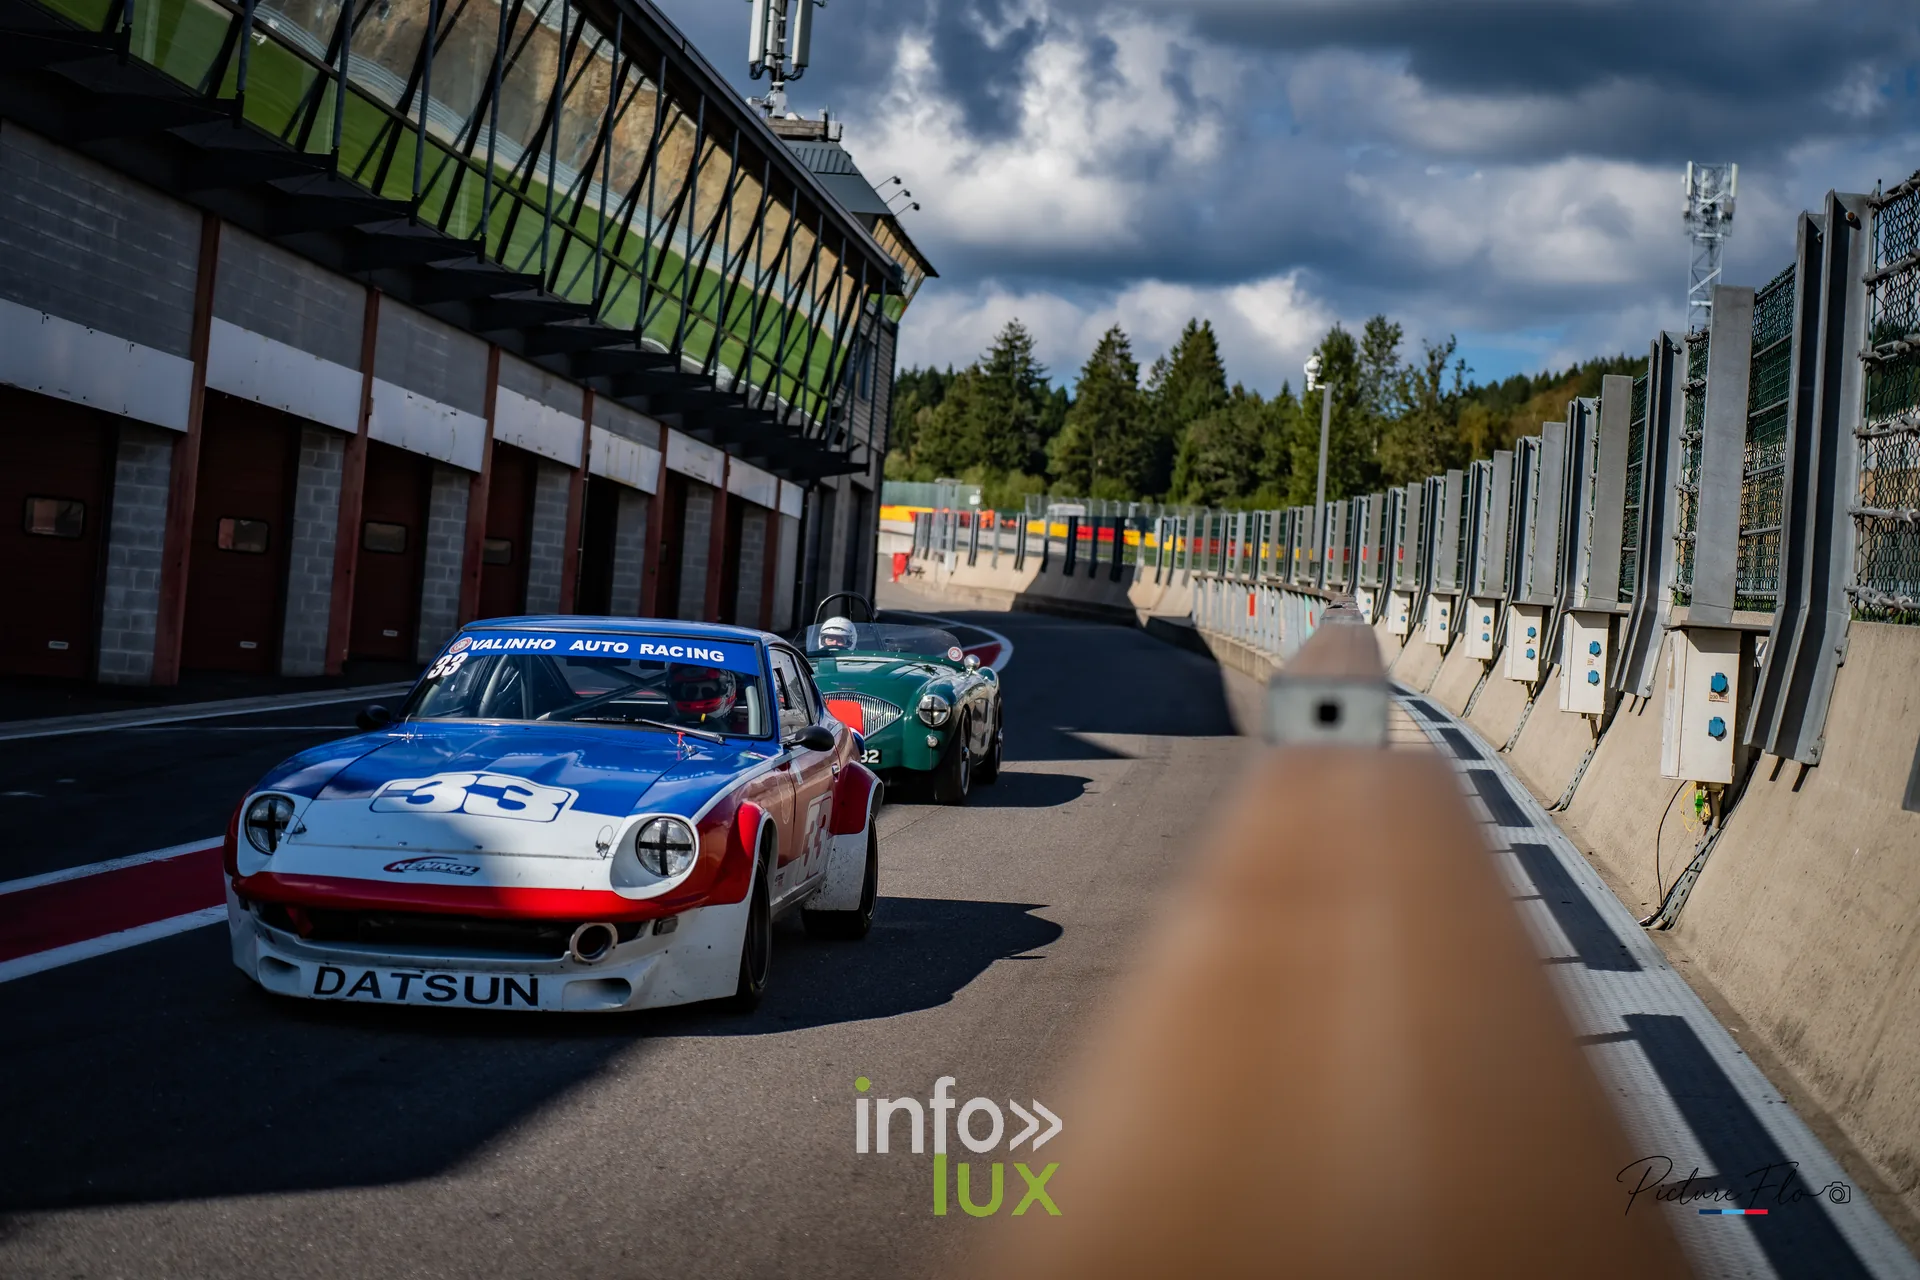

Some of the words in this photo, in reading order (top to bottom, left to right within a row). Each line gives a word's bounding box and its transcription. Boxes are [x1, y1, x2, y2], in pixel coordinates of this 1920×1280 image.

[470, 638, 557, 651] VALINHO
[569, 640, 629, 653] AUTO
[639, 643, 725, 662] RACING
[427, 652, 469, 680] 33
[368, 773, 572, 823] 33
[391, 862, 476, 874] KENNOL
[313, 966, 539, 1007] DATSUN
